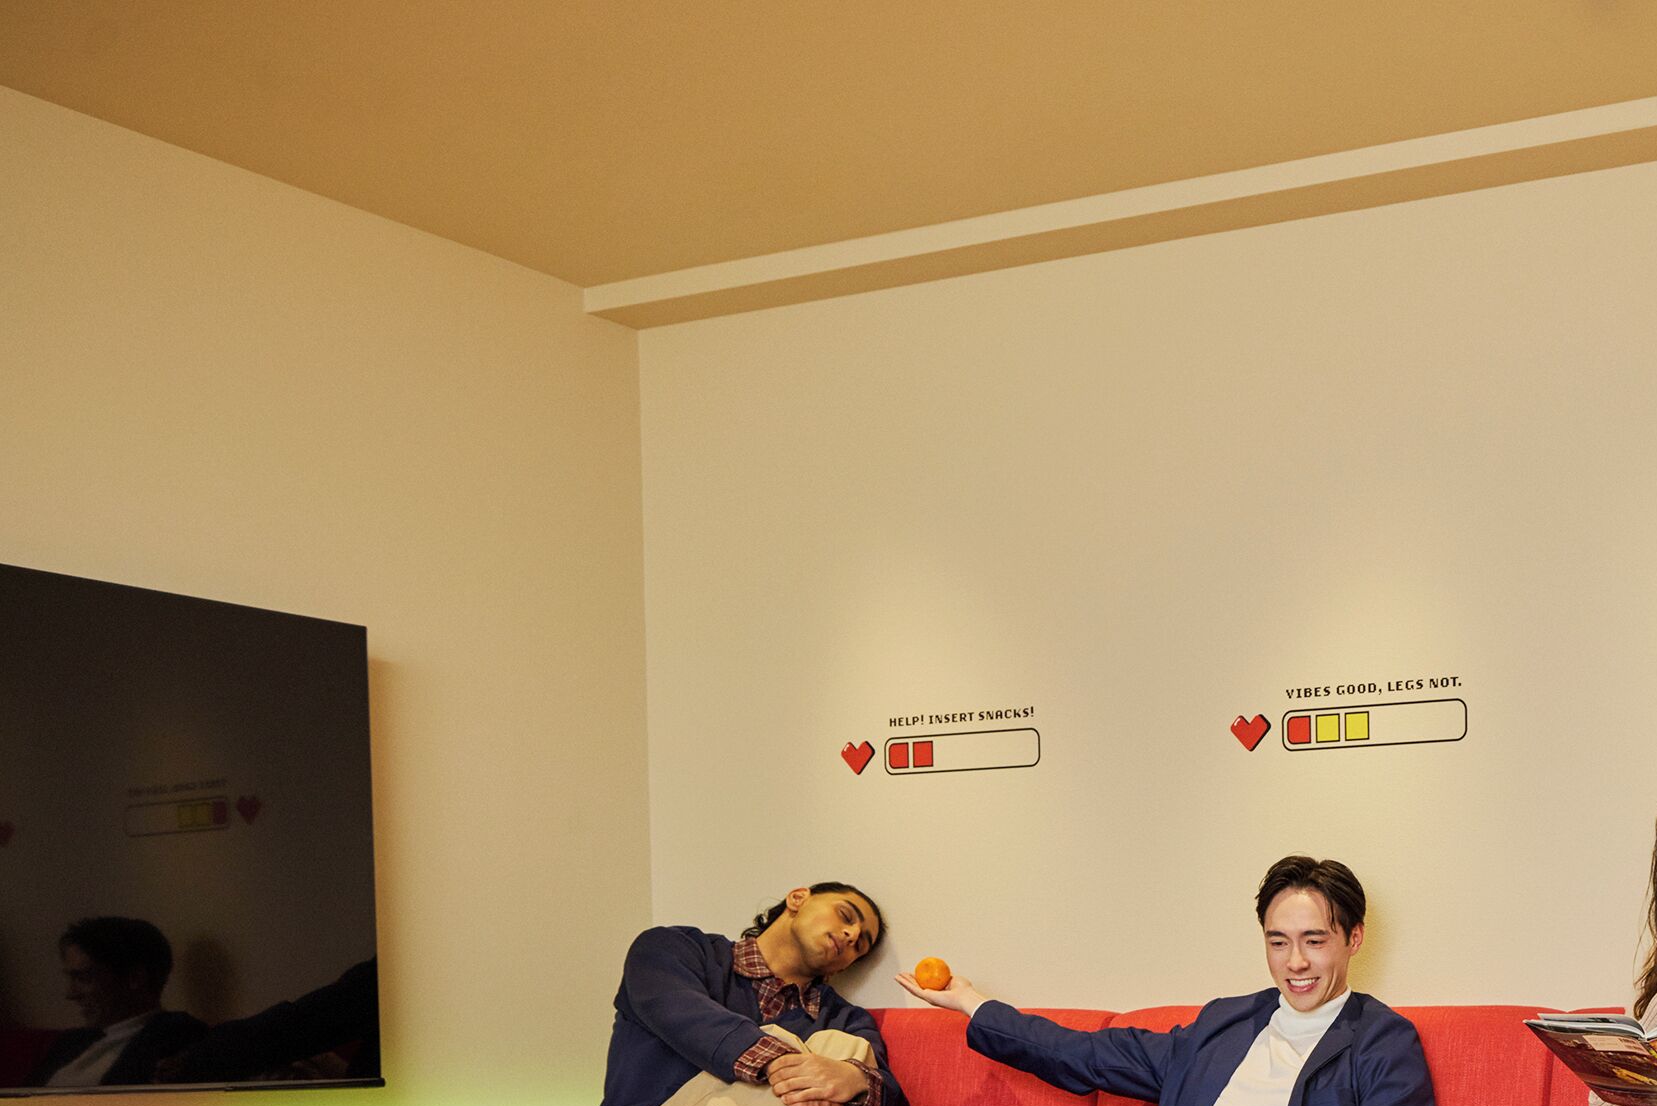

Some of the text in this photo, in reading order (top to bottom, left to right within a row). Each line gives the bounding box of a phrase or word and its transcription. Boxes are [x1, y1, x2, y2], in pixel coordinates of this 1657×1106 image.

[1285, 676, 1462, 700] VIBES GOOD, LEGS NOT.
[888, 705, 1035, 728] HELP! INSERT SNACKS!
